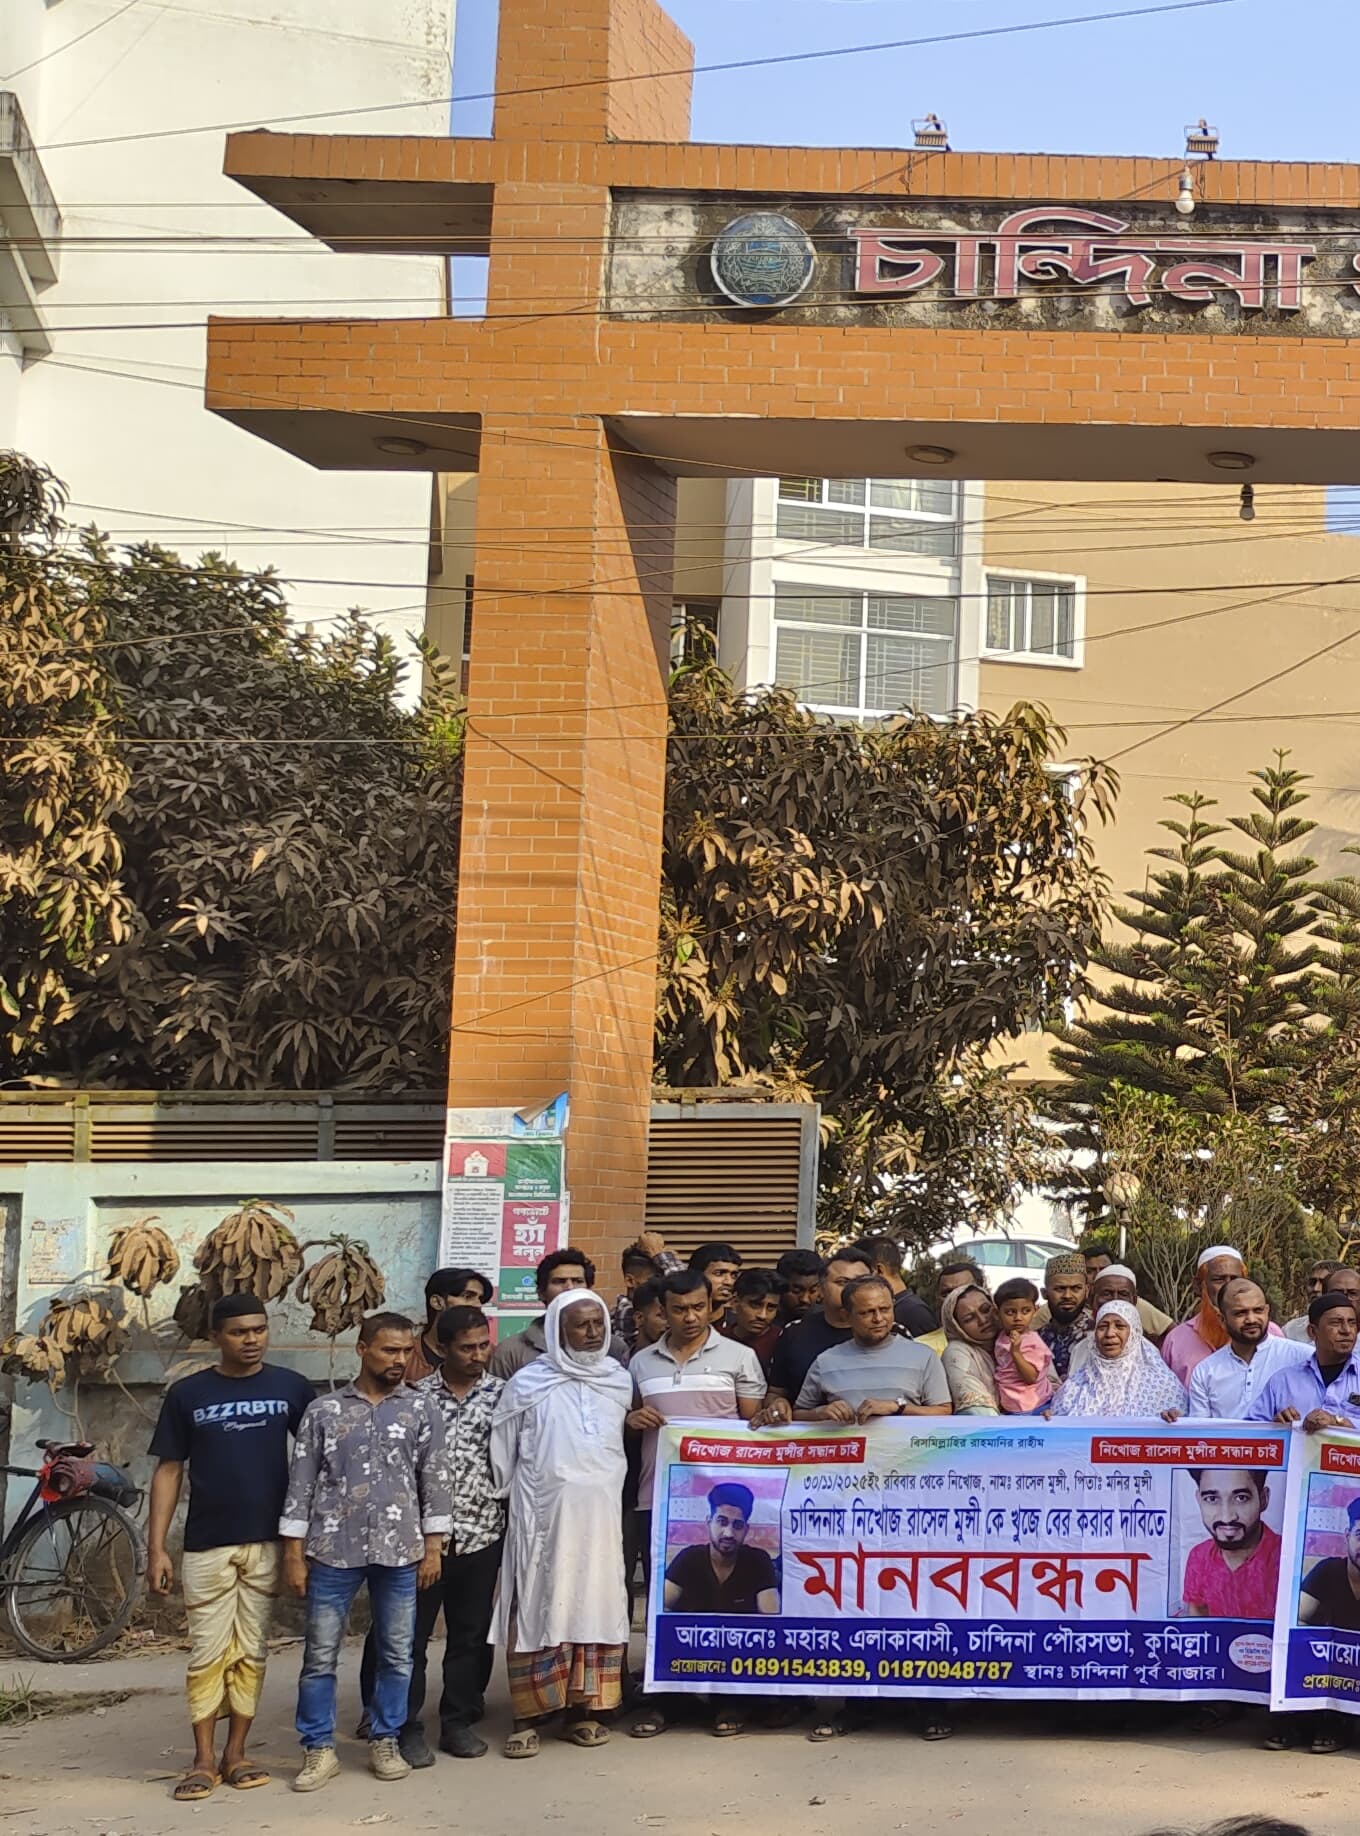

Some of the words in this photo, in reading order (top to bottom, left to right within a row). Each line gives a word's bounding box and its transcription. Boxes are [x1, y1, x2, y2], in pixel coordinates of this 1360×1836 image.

[847, 205, 1317, 311] চান্দিনা
[193, 1400, 289, 1422] BZZRBTR
[736, 1445, 771, 1458] রাসেল
[808, 1444, 836, 1458] সন্ধান
[840, 1441, 858, 1457] চাই
[1099, 1442, 1140, 1457] নিখোজ
[1146, 1444, 1181, 1458] রাসেল
[1222, 1445, 1253, 1458] সন্ধান
[1258, 1443, 1277, 1460] চাই
[884, 1471, 916, 1490] রবিবার
[920, 1474, 943, 1490] থেকে
[990, 1475, 1012, 1490] নামঃ
[1016, 1474, 1045, 1491] রাসেল
[1074, 1470, 1102, 1491] পিতাঃ
[1106, 1470, 1129, 1491] মনির
[790, 1498, 845, 1536] চান্দিনায়
[851, 1498, 901, 1536] নিখোজ
[908, 1506, 949, 1537] রাসেল
[987, 1508, 1006, 1537] কে
[1012, 1504, 1042, 1542] খুজে
[1046, 1508, 1072, 1536] বের
[1077, 1504, 1113, 1537] করার
[1119, 1498, 1167, 1537] দাবিতে
[793, 1541, 1153, 1613] মানববন্ধন
[675, 1624, 775, 1649] আয়োজনেঃ
[784, 1626, 842, 1652] মহারং
[850, 1622, 958, 1656] এলাকাবাসী,
[968, 1624, 1036, 1654] চান্দিনা
[1043, 1623, 1134, 1657] পৌরসভা,
[1144, 1626, 1220, 1658] কুমিল্লা।
[670, 1660, 726, 1674] প্রয়োজনেঃ
[731, 1658, 870, 1681] 01891543839,
[878, 1660, 1013, 1680] 01870948787
[1024, 1664, 1063, 1681] স্থানঃ
[1071, 1661, 1127, 1681] চান্দিনা
[1133, 1656, 1162, 1685] পূর্ব
[1166, 1665, 1224, 1681] বাজার।
